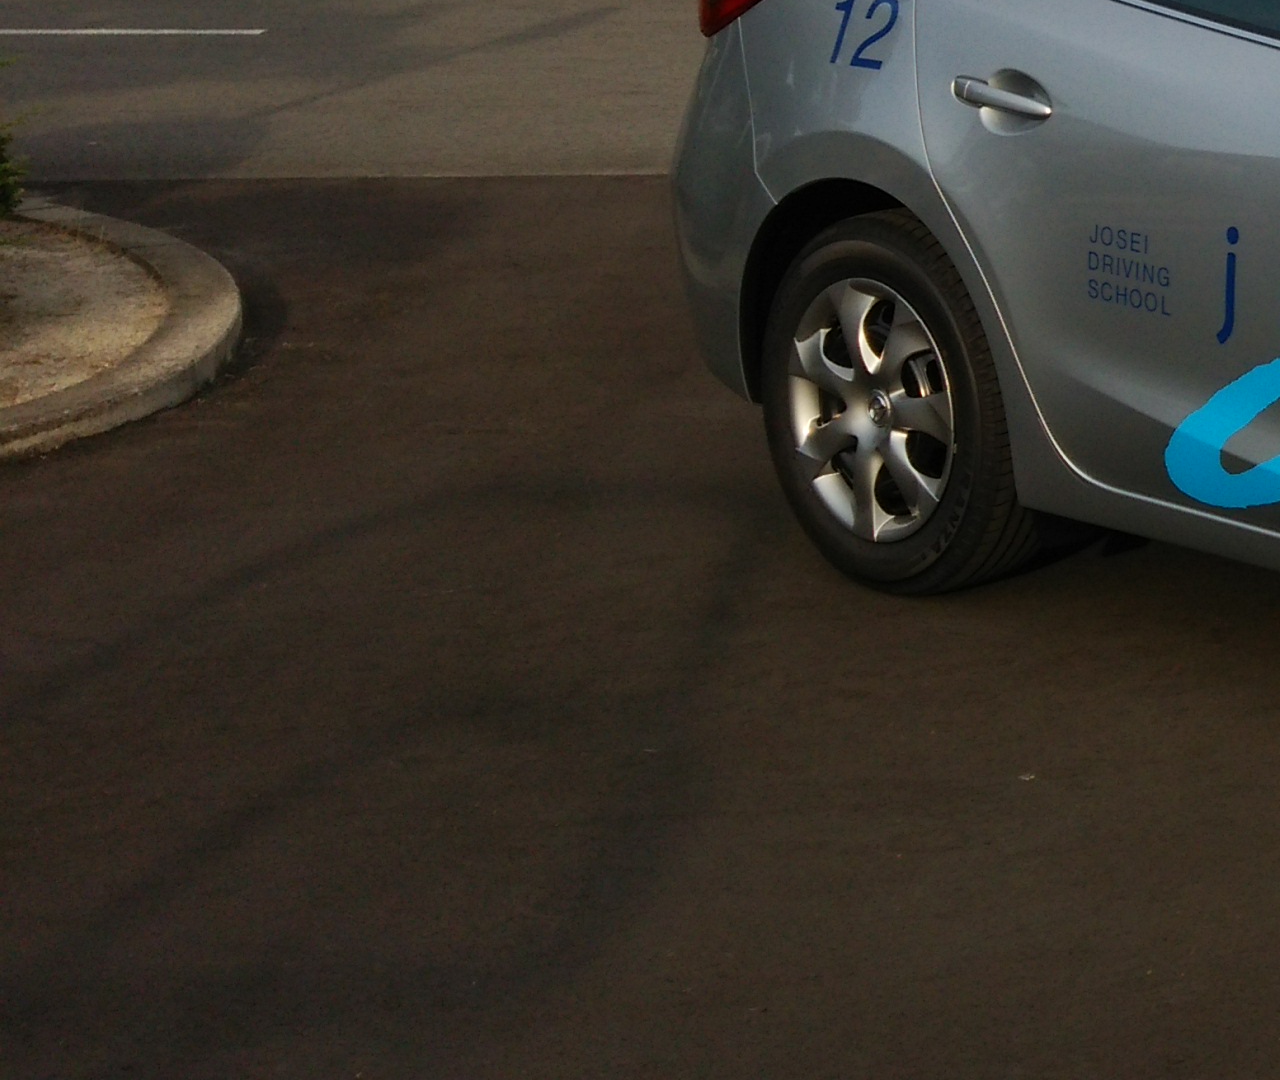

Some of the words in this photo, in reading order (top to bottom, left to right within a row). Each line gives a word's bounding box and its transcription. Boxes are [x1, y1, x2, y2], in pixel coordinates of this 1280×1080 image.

[1089, 224, 1149, 254] JOSEI
[1088, 251, 1171, 287] DRIVING
[1088, 278, 1172, 316] SCHOOL
